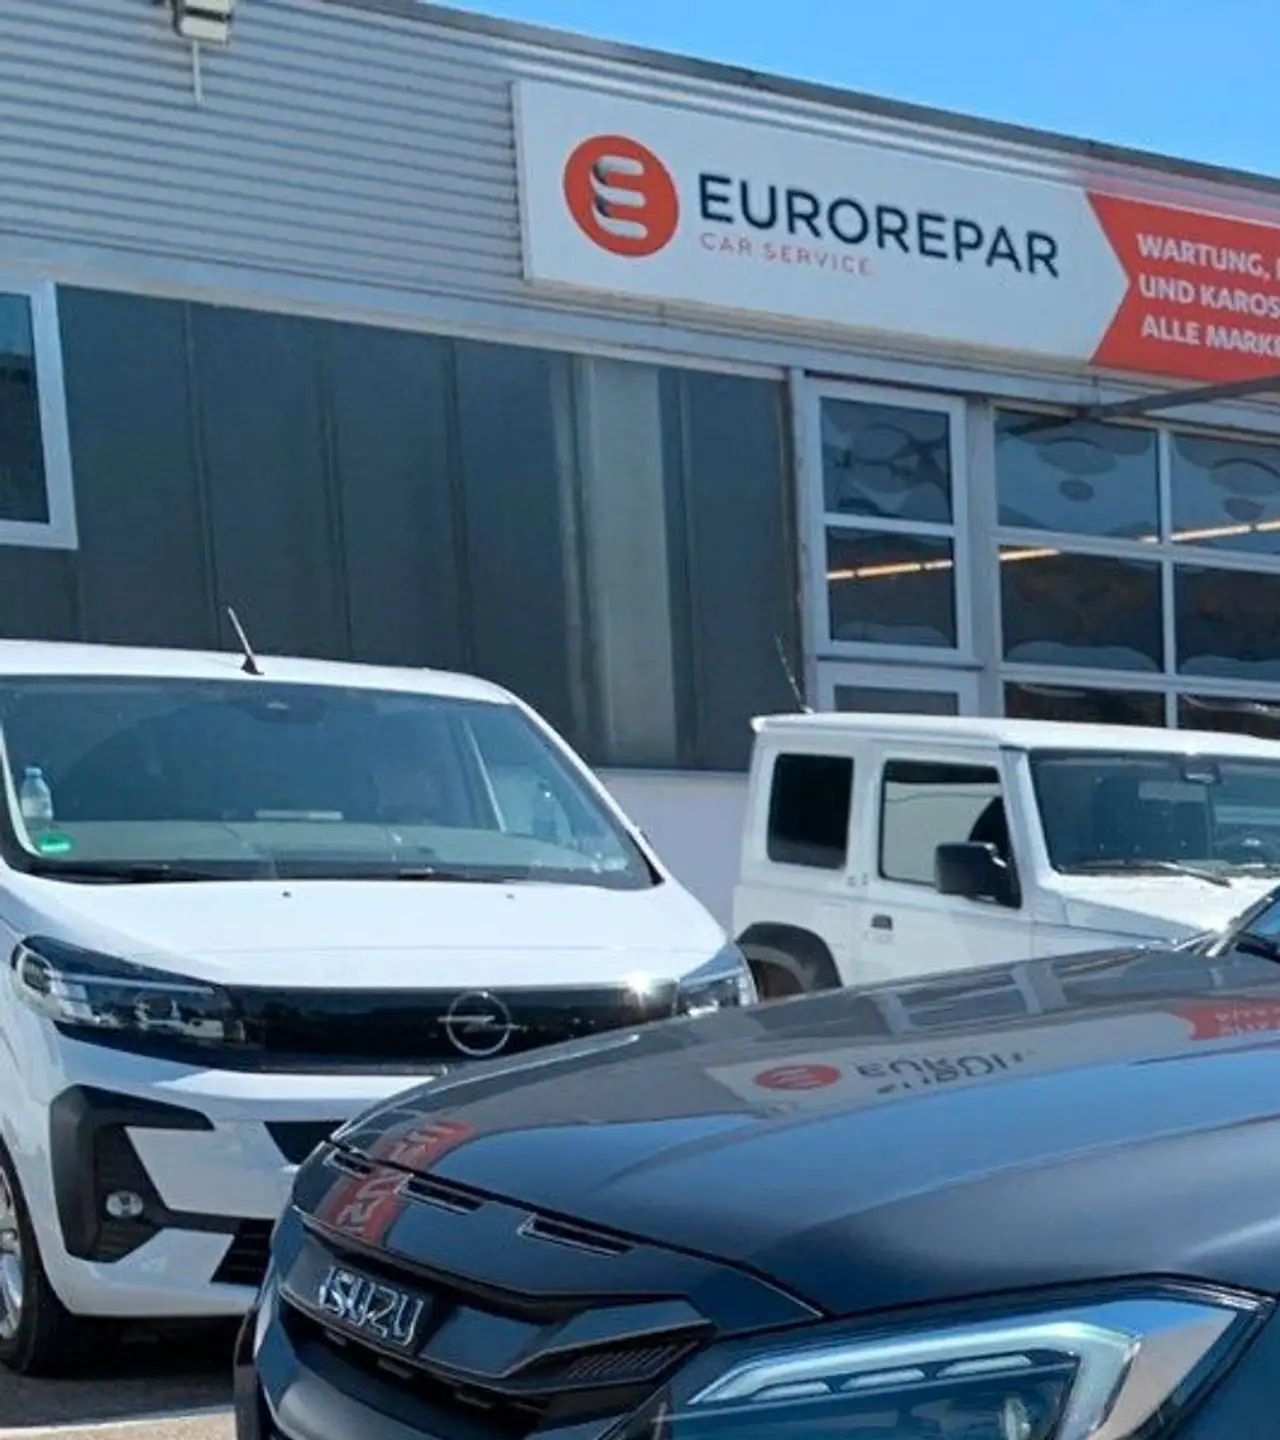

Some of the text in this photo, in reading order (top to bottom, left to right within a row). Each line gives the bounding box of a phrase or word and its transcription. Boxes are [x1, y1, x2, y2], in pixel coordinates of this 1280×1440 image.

[699, 173, 1059, 278] EUROREPAR
[700, 232, 873, 276] CAR SERVICE
[1136, 233, 1271, 281] WARTUNG,
[1139, 273, 1195, 304] UND
[1141, 313, 1200, 346] ALLE
[318, 1265, 424, 1347] ISUZU
